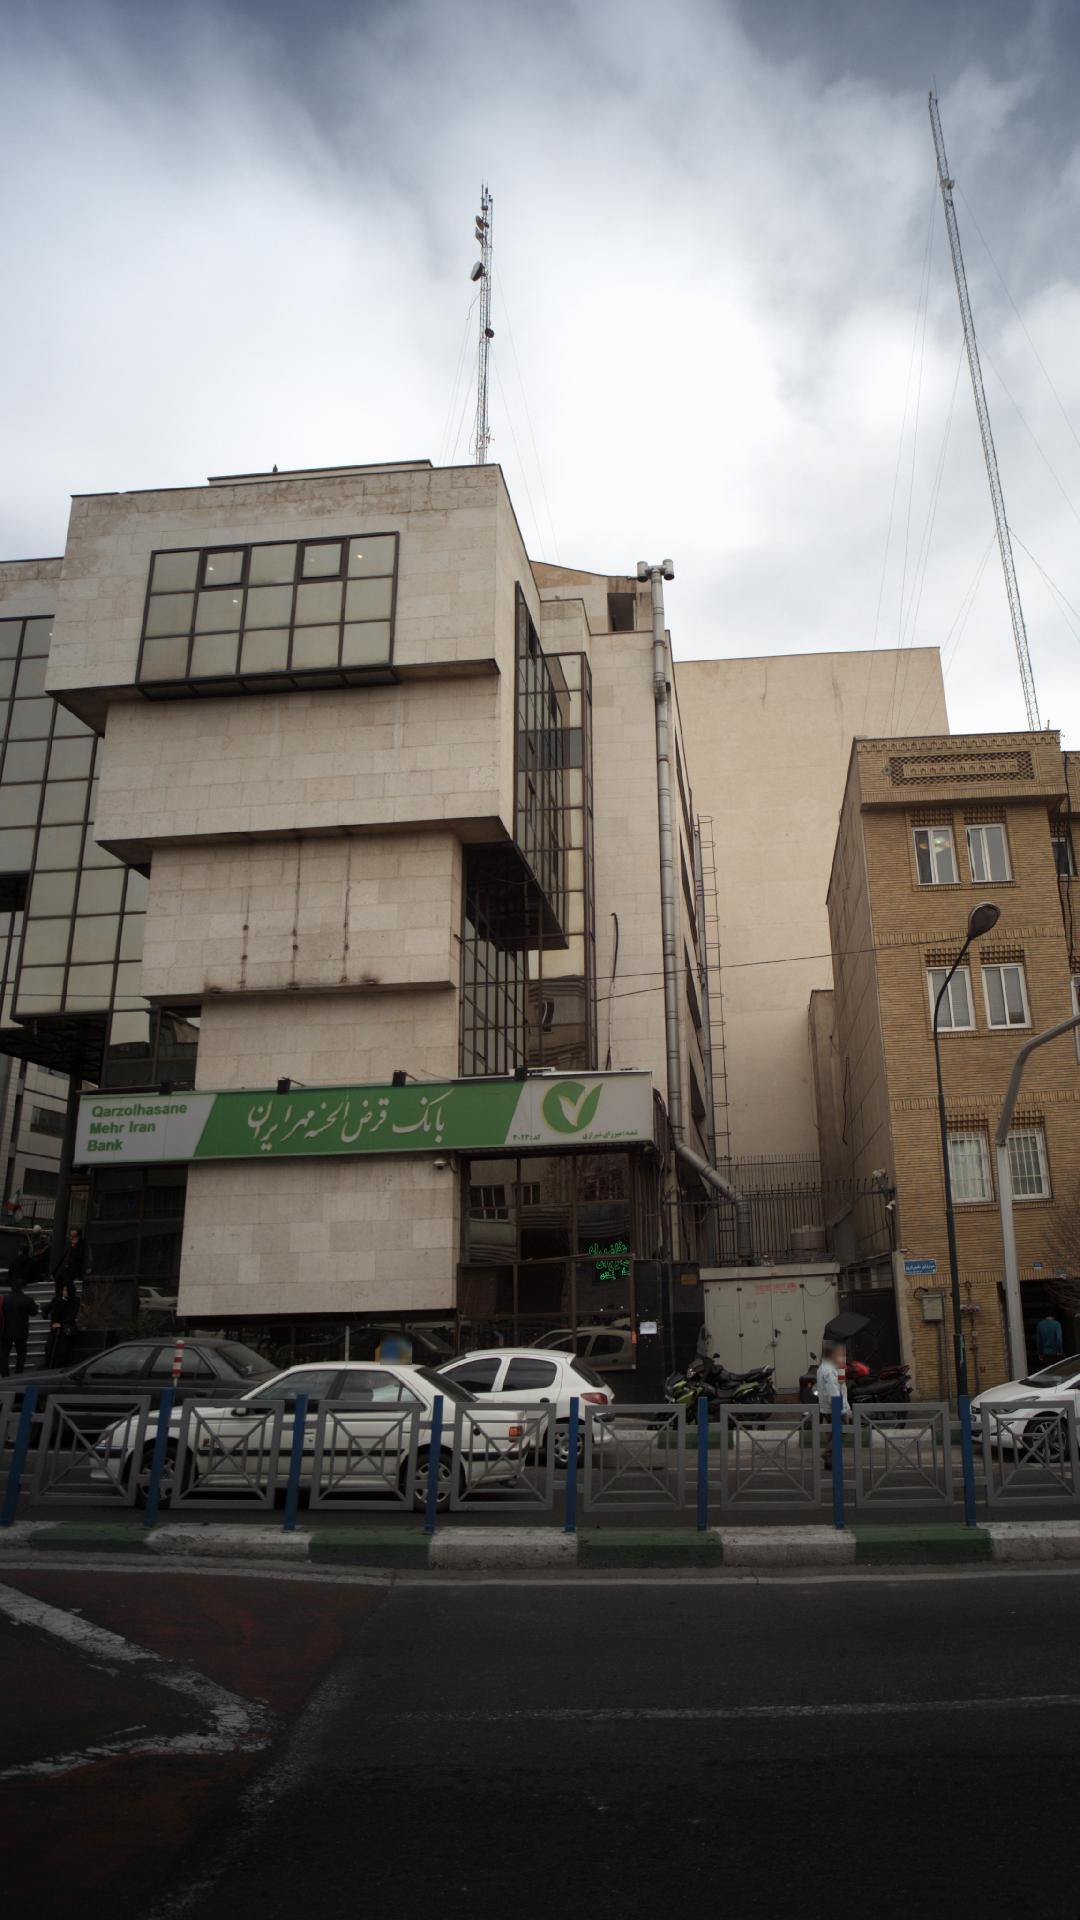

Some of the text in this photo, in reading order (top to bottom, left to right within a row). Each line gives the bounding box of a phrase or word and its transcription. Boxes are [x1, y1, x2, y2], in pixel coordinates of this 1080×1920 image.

[91, 1103, 187, 1118] Qarzolhasane
[392, 1088, 455, 1143] بانک
[89, 1121, 156, 1135] Mehr Iran
[247, 1100, 293, 1151] ایران
[280, 1109, 316, 1142] مهر
[87, 1139, 123, 1152] Bank
